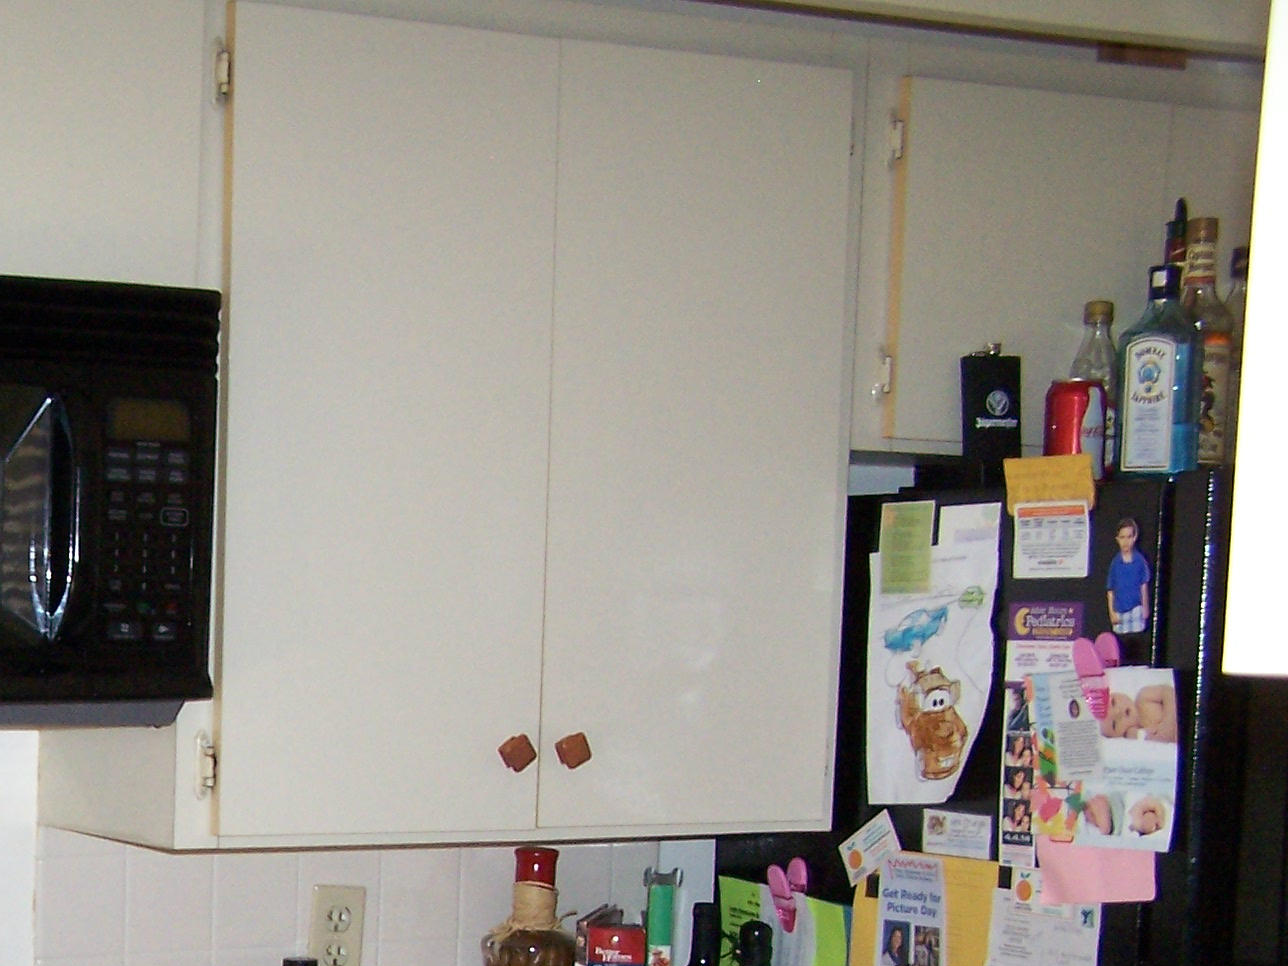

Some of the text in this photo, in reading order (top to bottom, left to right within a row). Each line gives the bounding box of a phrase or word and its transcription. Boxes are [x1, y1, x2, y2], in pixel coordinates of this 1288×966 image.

[882, 888, 899, 899] Get
[900, 889, 928, 904] Ready
[886, 901, 938, 918] Picture Day
